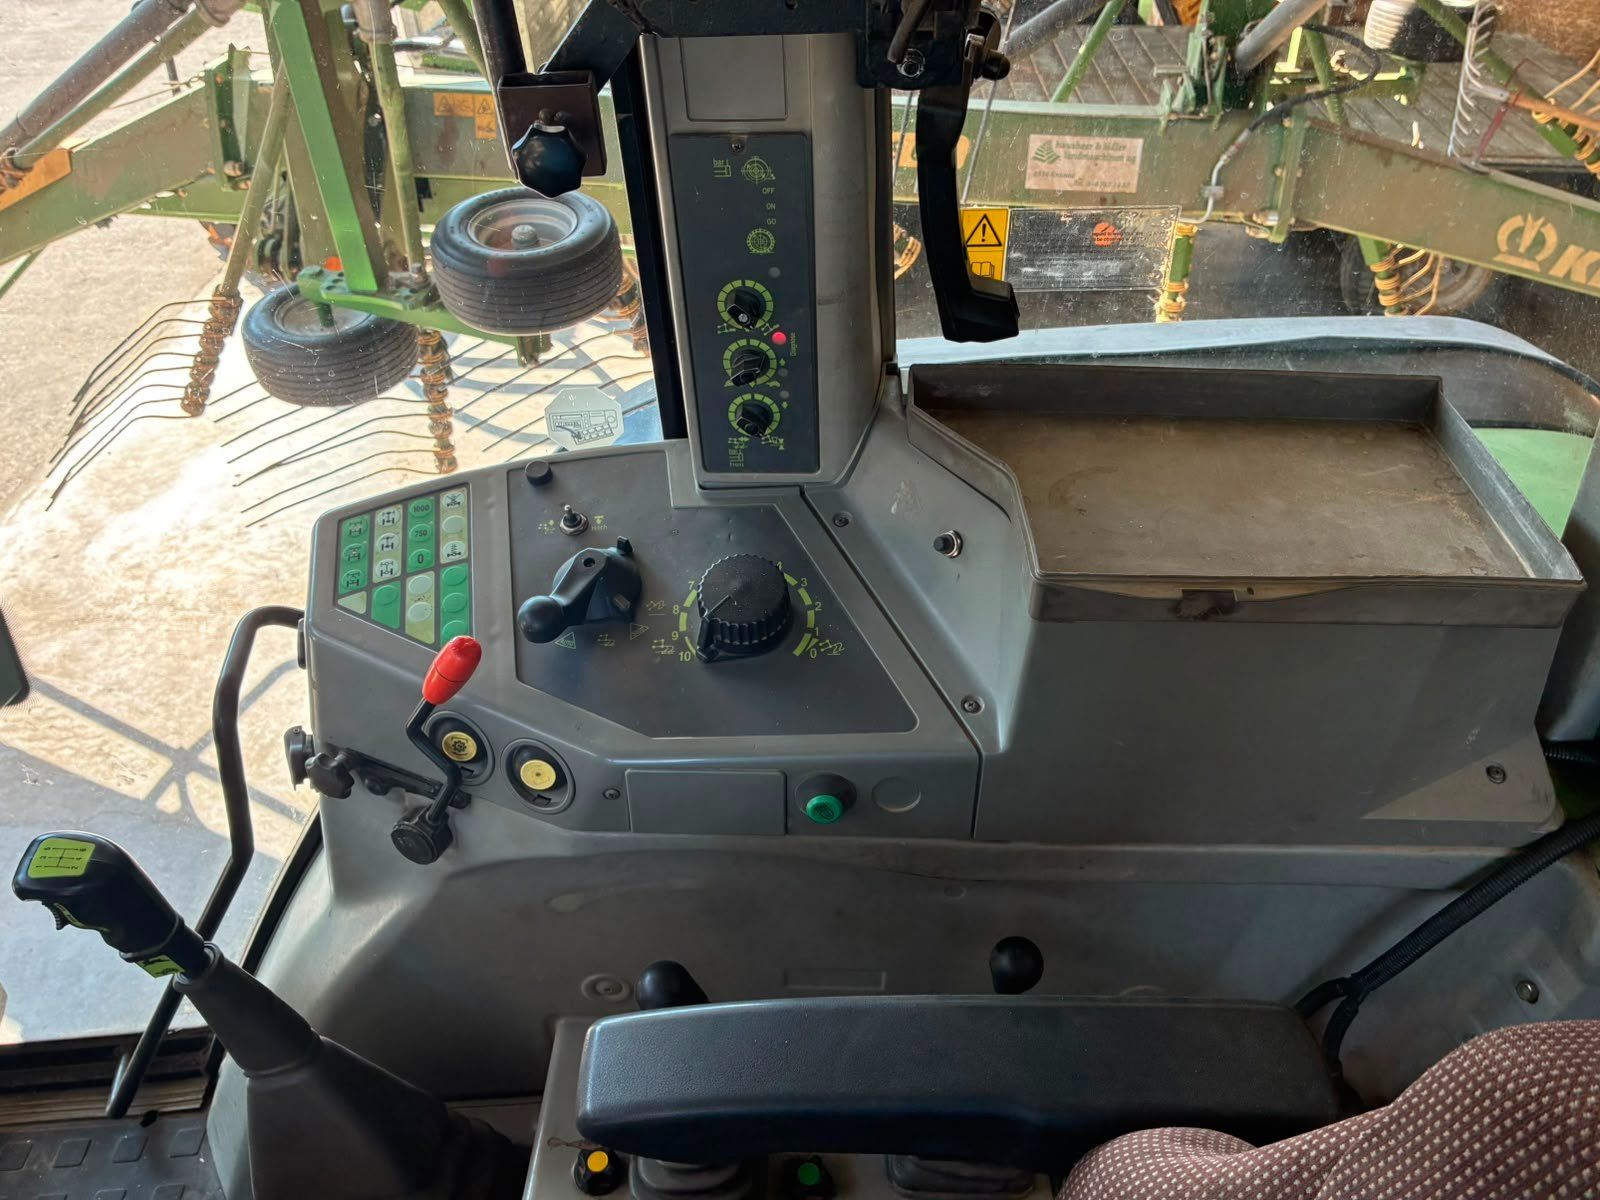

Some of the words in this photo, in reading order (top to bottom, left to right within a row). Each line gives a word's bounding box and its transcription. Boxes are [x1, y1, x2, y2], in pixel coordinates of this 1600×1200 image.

[766, 202, 776, 210] ON
[414, 504, 430, 512] 1000
[417, 553, 424, 564] 0
[688, 580, 695, 590] 7
[800, 578, 808, 586] 3
[672, 604, 680, 614] 8
[814, 602, 822, 610] 2
[672, 631, 678, 640] 9
[814, 627, 819, 636] 1
[679, 652, 691, 662] 10
[810, 648, 817, 658] 0
